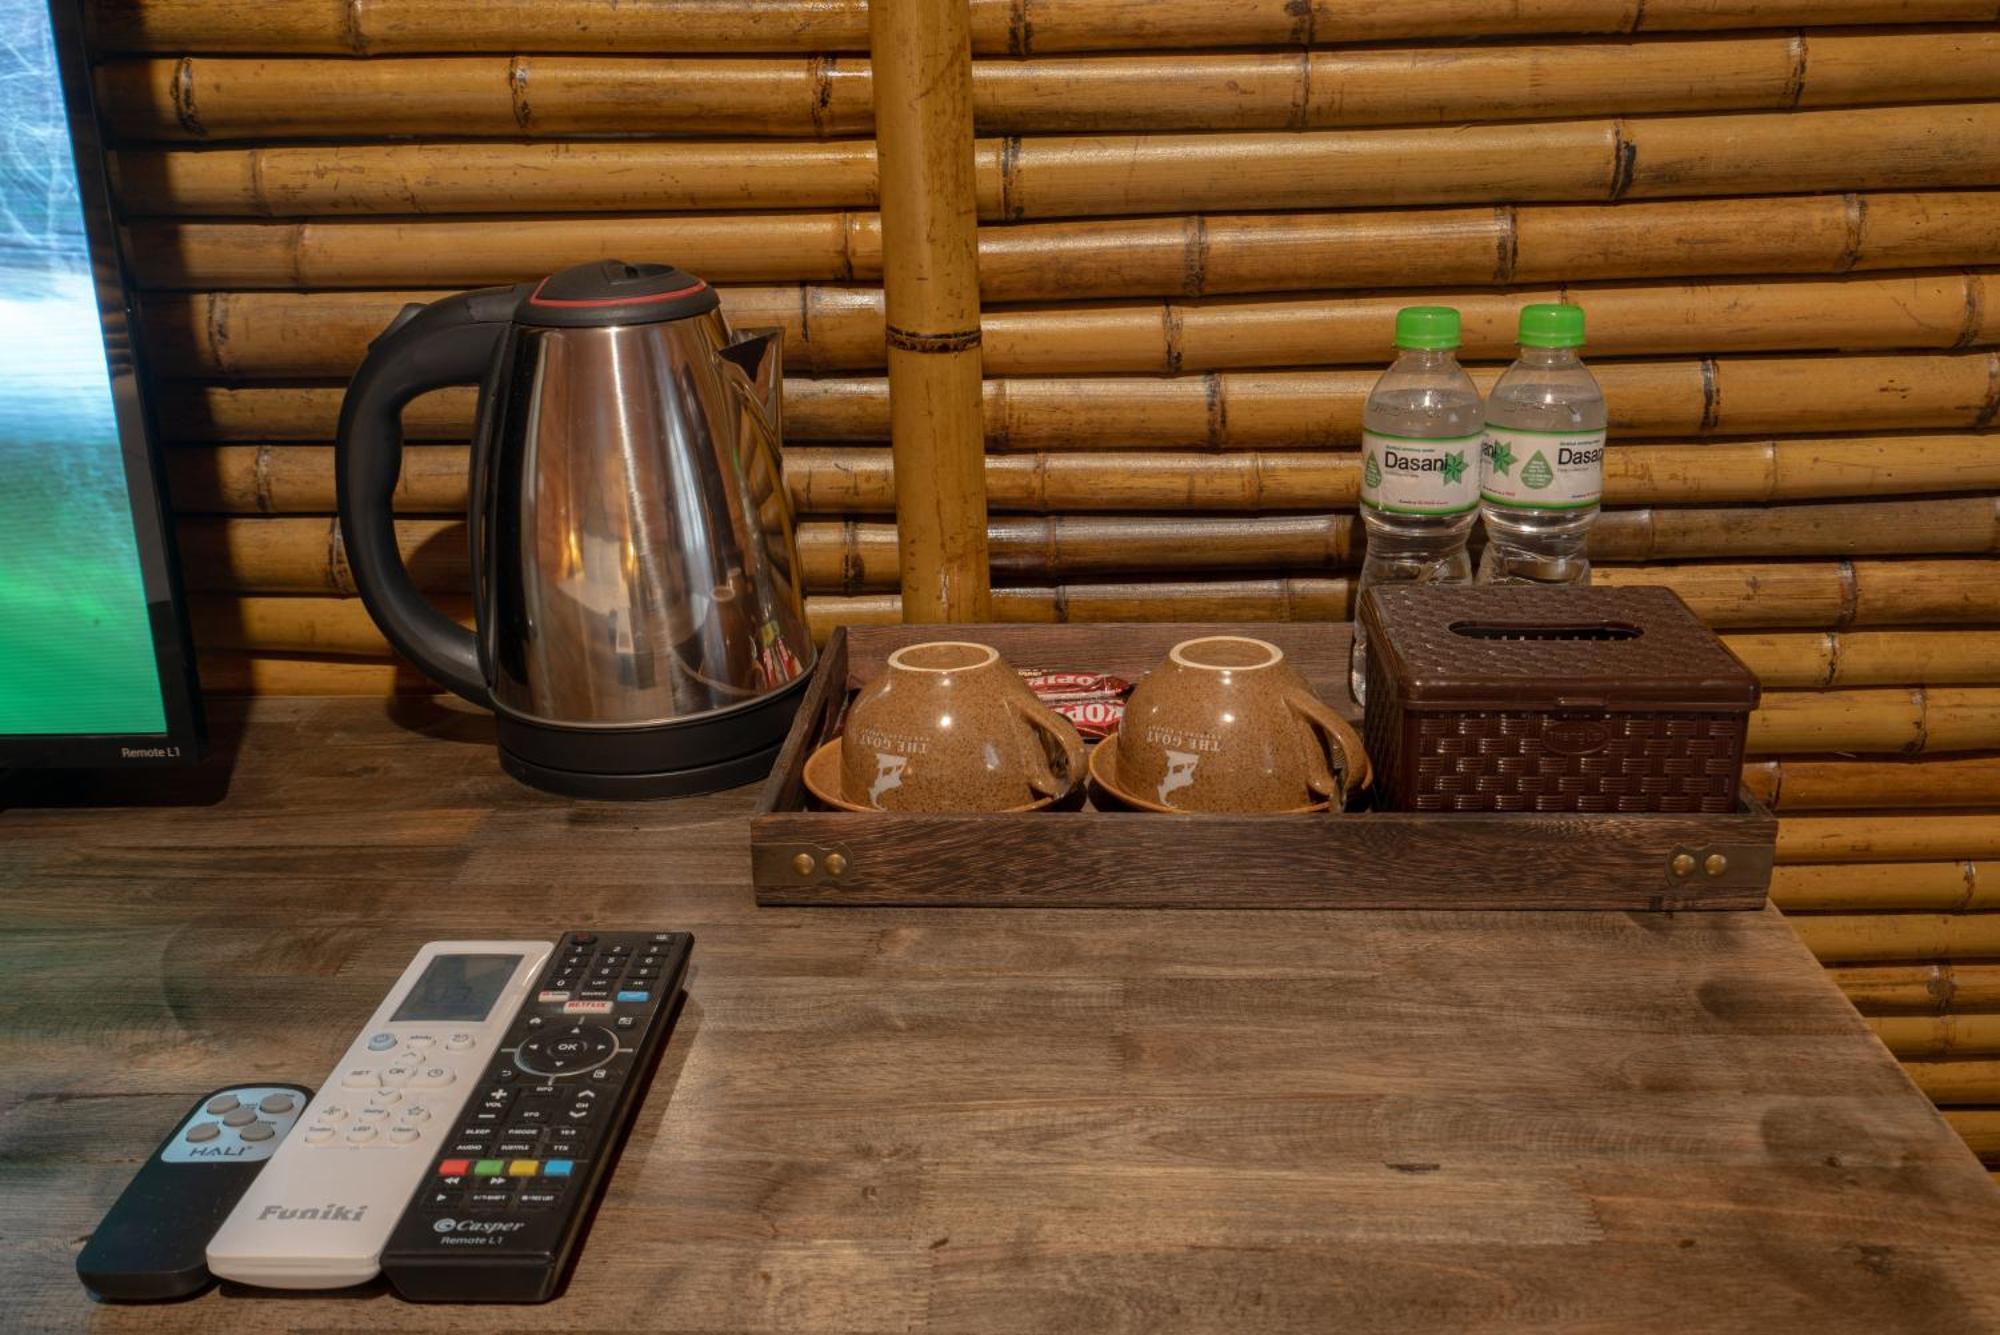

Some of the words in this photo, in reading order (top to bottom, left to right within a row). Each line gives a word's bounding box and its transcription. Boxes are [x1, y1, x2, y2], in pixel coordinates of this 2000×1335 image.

[1385, 451, 1448, 471] Dasani
[1190, 738, 1221, 752] THE
[121, 747, 166, 758] Remote
[558, 1043, 578, 1051] OK
[389, 1068, 405, 1076] OK
[257, 1204, 368, 1222] Funiki
[456, 1220, 524, 1234] Casper
[440, 1236, 486, 1244] Remote
